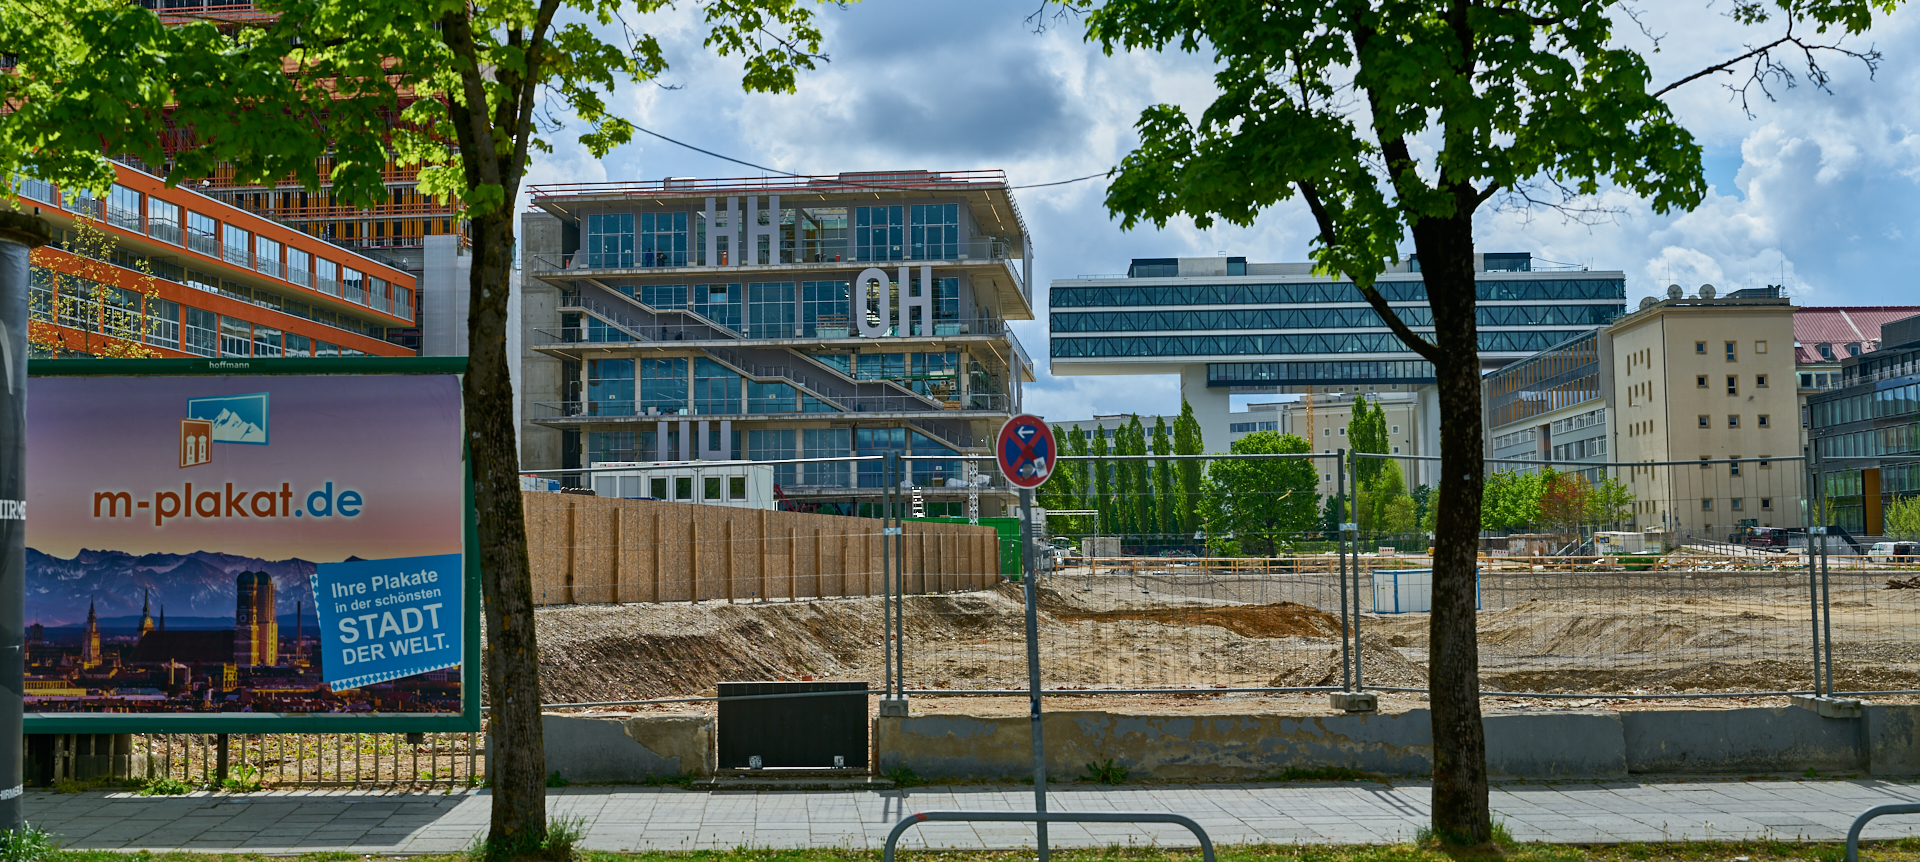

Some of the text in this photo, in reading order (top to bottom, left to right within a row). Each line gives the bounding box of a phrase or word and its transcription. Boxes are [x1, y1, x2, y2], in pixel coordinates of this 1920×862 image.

[705, 195, 780, 266] HH
[856, 266, 933, 338] OH
[209, 361, 250, 369] hoffmann
[94, 482, 363, 526] m-plakat.de
[331, 569, 438, 598] Ihre Plakate
[335, 588, 442, 613] in der schönsten
[338, 603, 443, 644] STADT
[342, 633, 450, 665] DER WELT.
